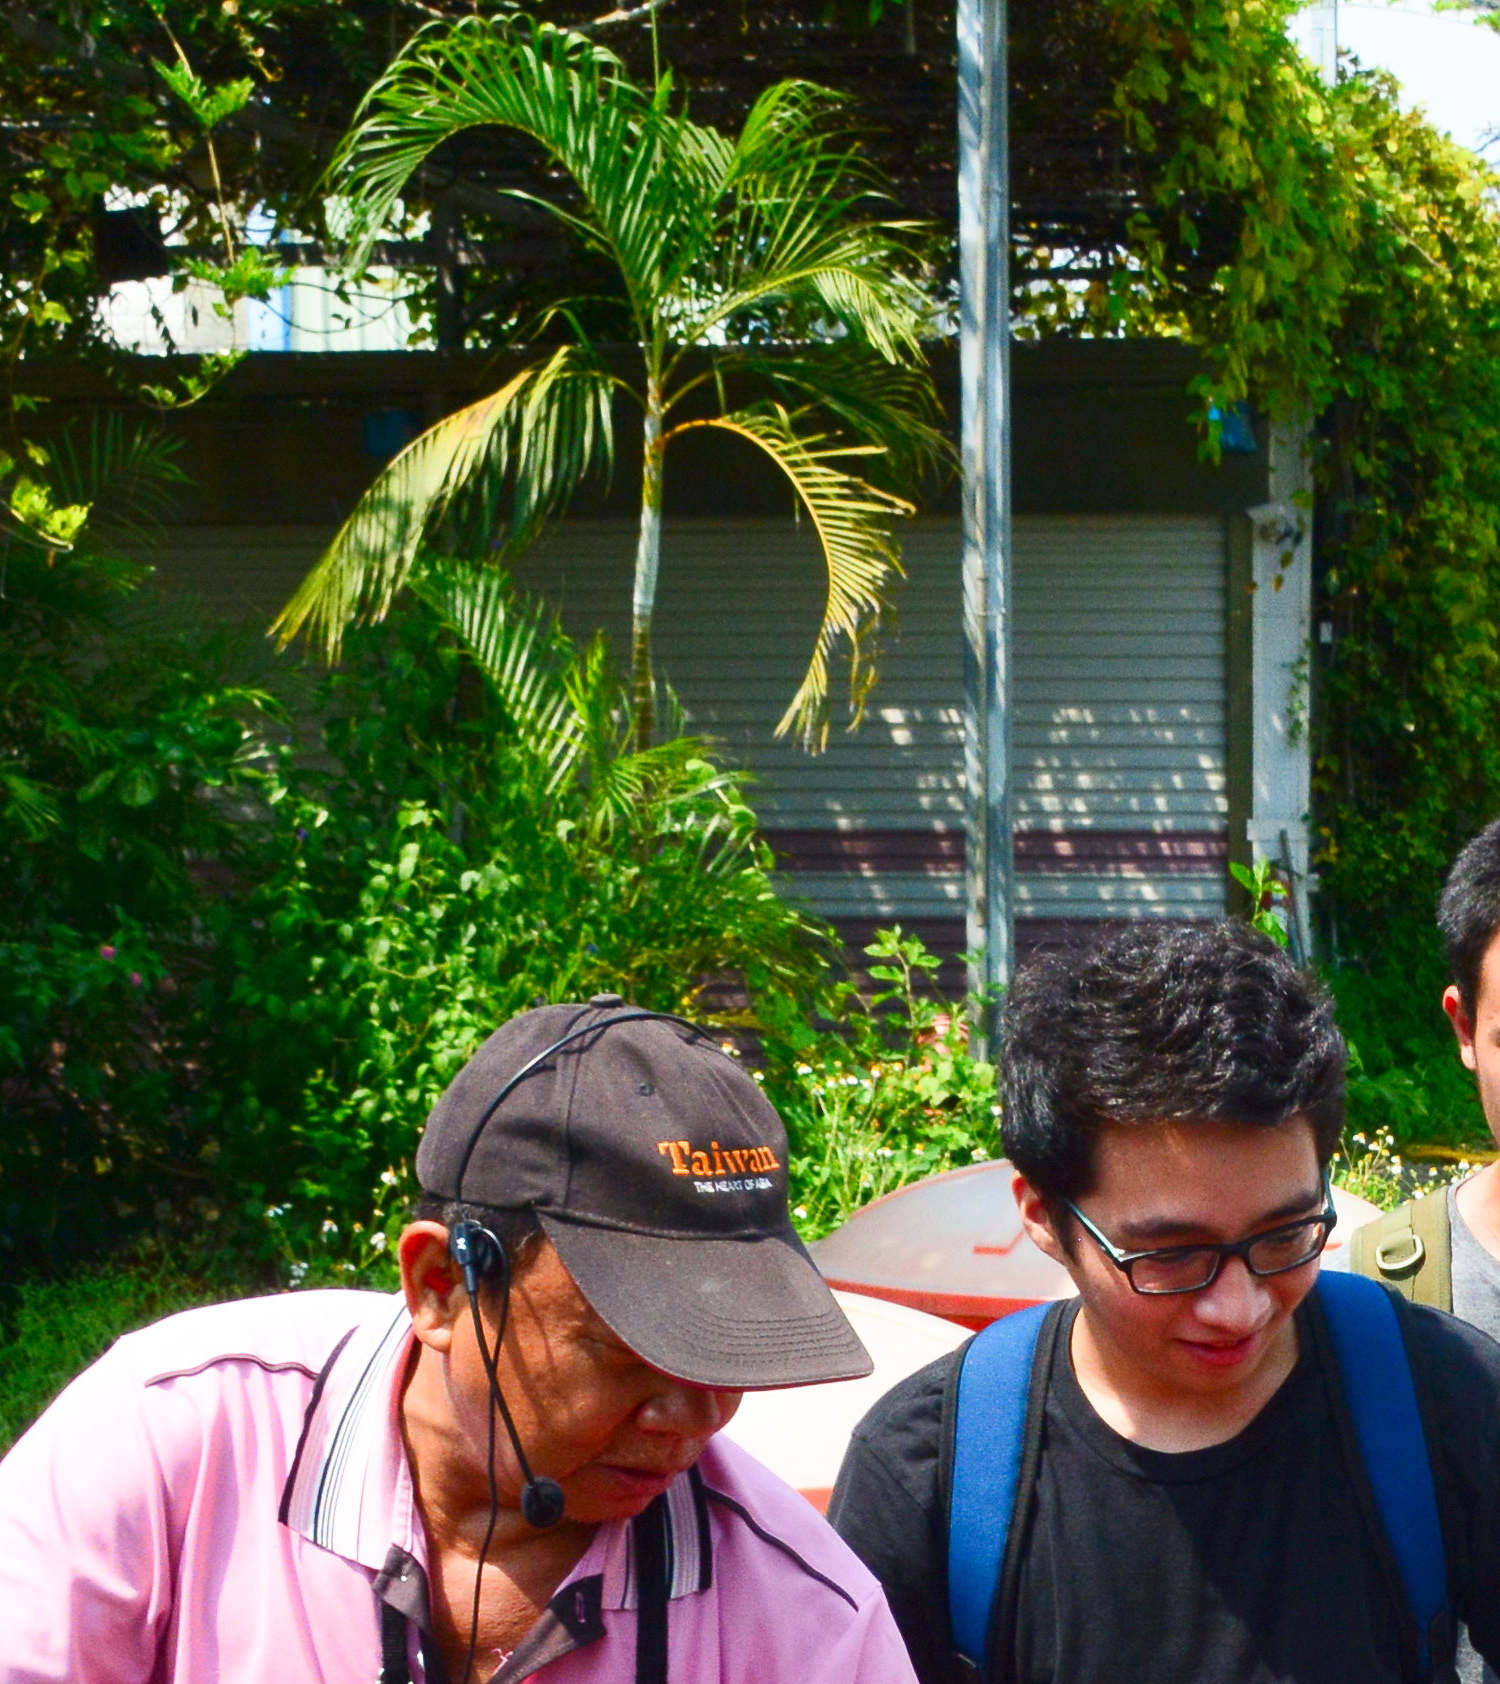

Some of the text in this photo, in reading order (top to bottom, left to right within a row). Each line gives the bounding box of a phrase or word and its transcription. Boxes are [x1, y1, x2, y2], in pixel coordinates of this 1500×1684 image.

[657, 1140, 781, 1176] Taiwan
[693, 1181, 715, 1193] THE
[715, 1180, 743, 1192] HEART
[744, 1179, 755, 1191] OF
